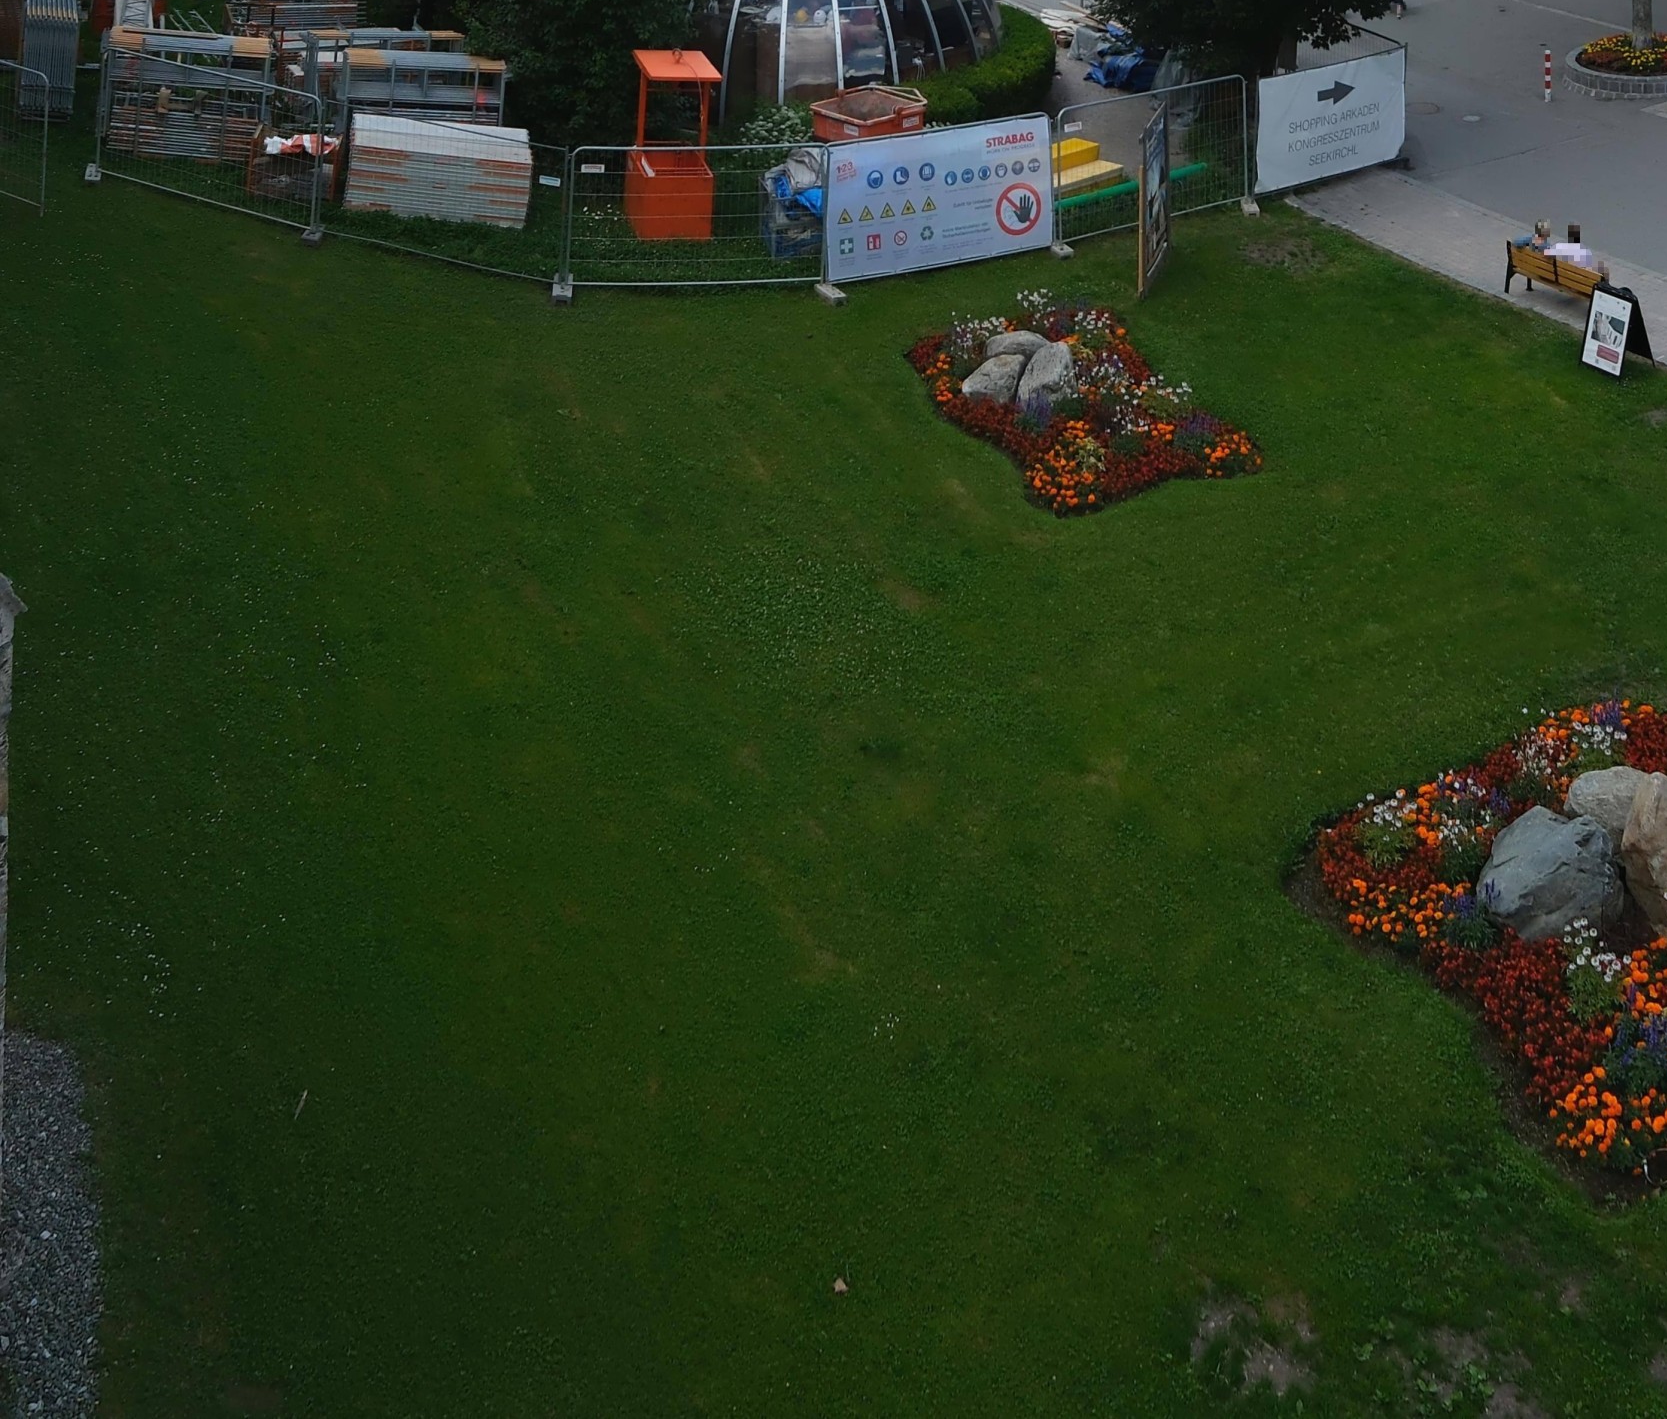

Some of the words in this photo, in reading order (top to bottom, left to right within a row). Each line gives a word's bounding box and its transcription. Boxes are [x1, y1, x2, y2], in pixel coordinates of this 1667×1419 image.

[1288, 112, 1338, 134] SHOPPING
[1339, 102, 1380, 122] ARKADEN
[985, 131, 1035, 148] STRABAG
[1287, 120, 1380, 153] KONGRESSZENTRUM
[1308, 146, 1359, 167] SEEKIRCHL
